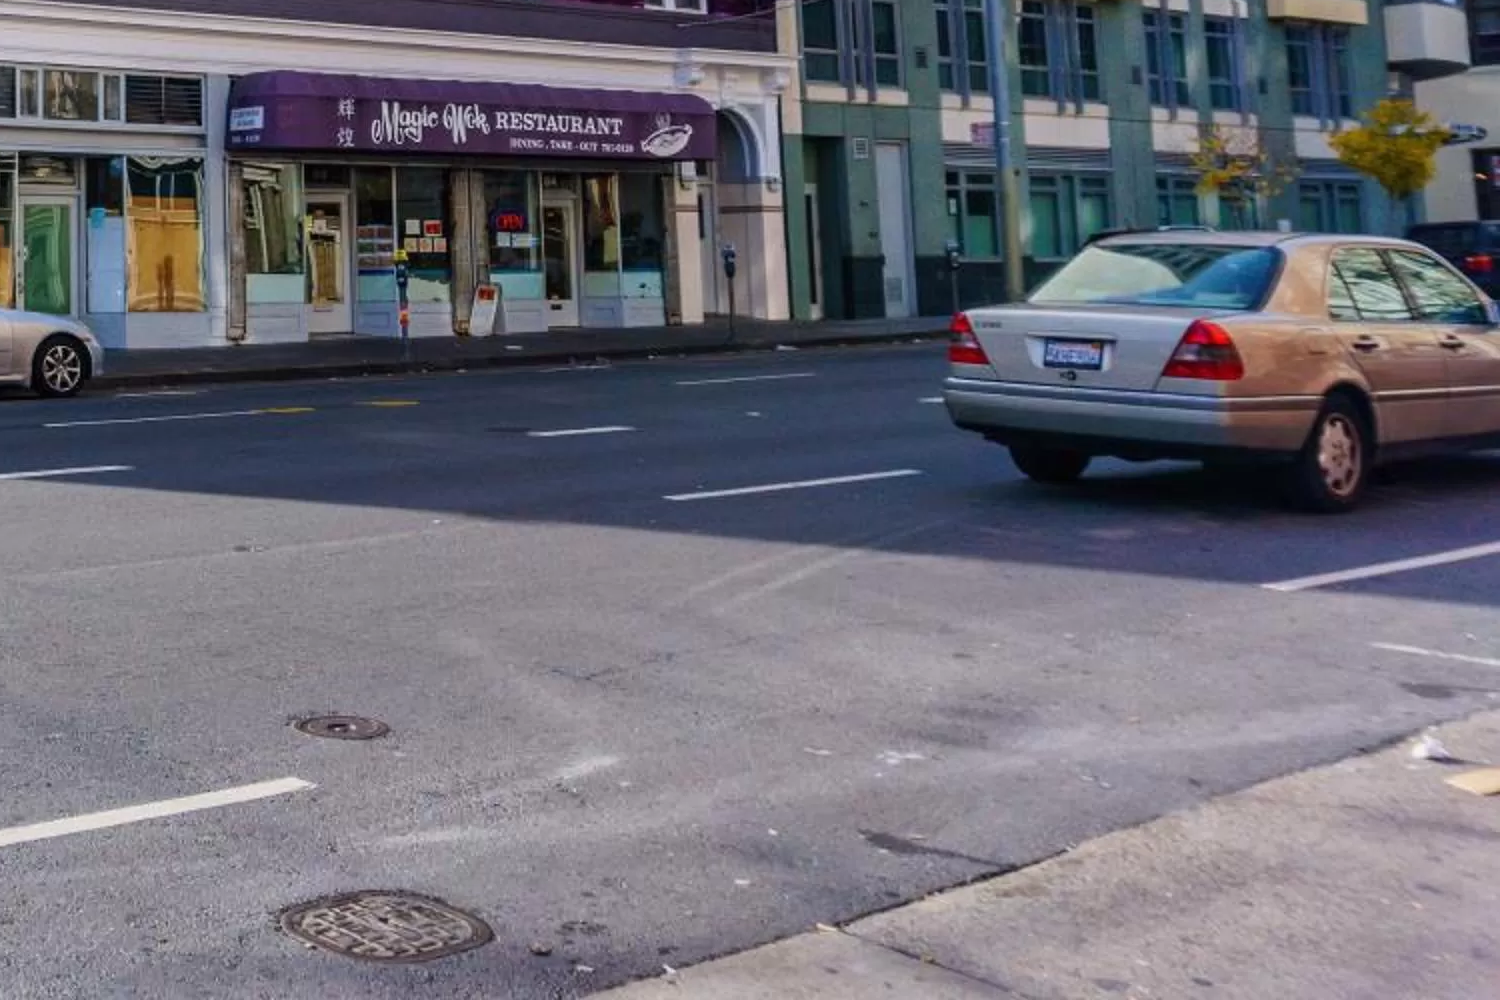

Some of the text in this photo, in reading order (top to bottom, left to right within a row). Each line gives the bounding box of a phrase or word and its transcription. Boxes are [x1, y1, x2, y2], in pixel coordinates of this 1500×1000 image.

[371, 101, 623, 145] Magic Wok RESTAURANT
